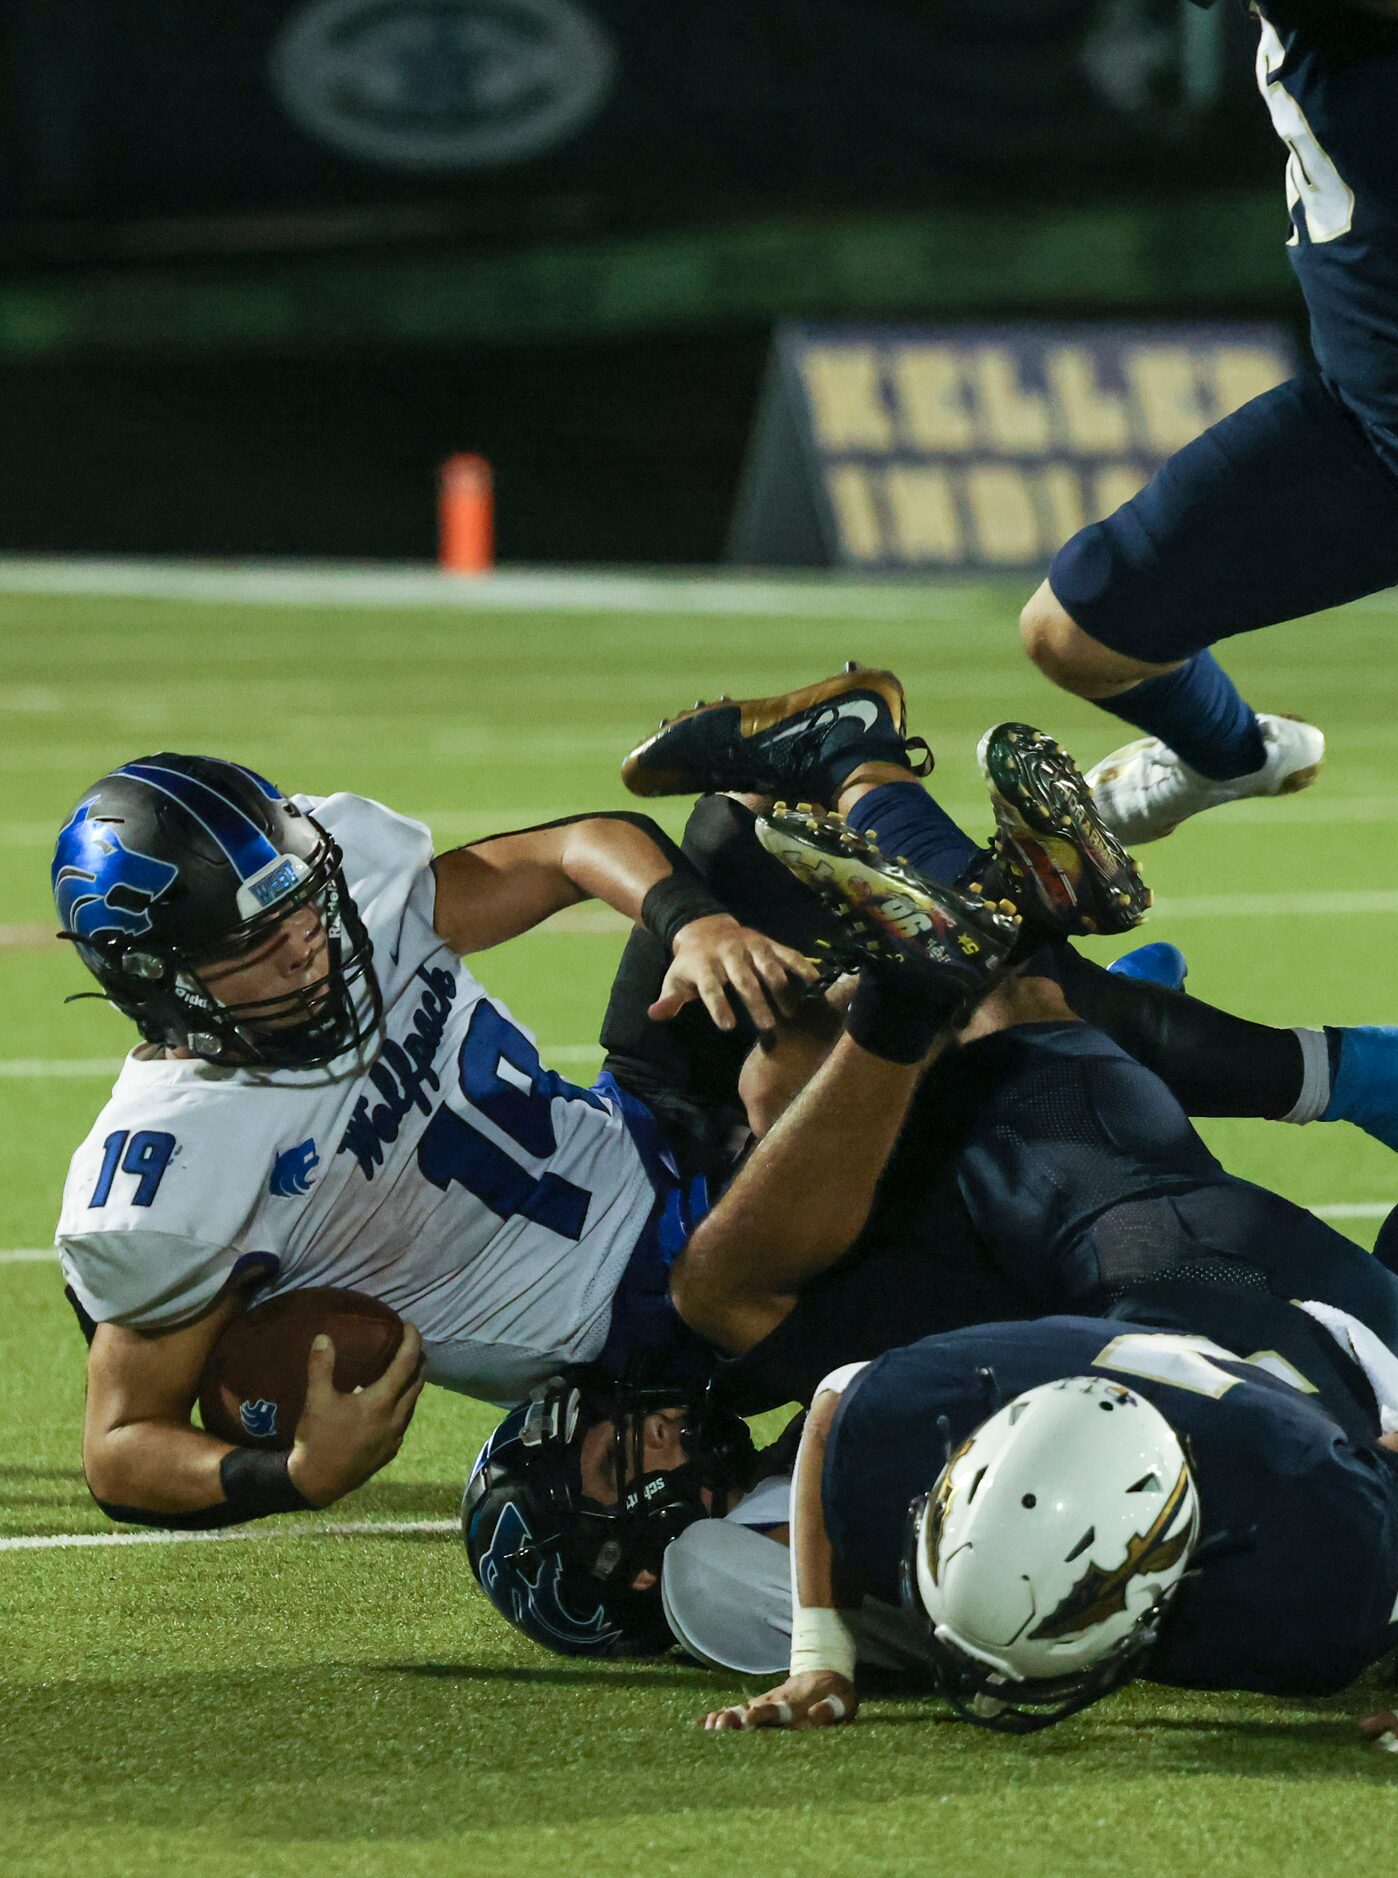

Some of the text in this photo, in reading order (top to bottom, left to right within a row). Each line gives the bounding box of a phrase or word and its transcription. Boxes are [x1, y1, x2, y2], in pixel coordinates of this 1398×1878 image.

[249, 861, 298, 906] WEST
[335, 964, 457, 1181] Wolfpack
[87, 1129, 177, 1210] 19
